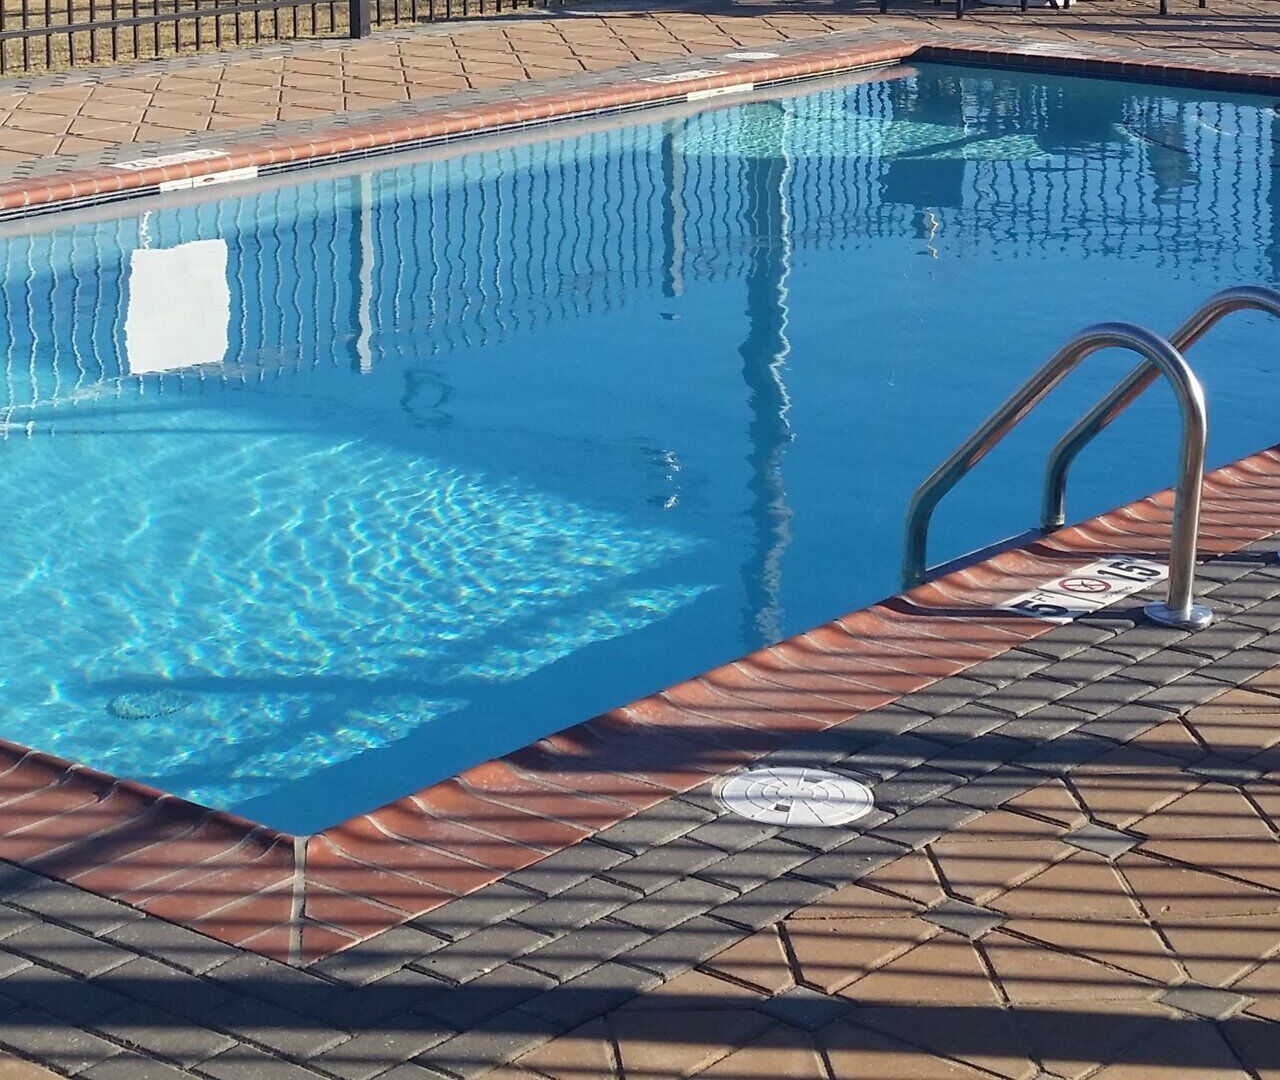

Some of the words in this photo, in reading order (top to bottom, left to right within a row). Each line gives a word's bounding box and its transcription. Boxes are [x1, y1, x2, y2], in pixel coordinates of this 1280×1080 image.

[1097, 561, 1162, 583] 1.5
[1031, 592, 1055, 603] FT
[1010, 599, 1069, 617] 5
